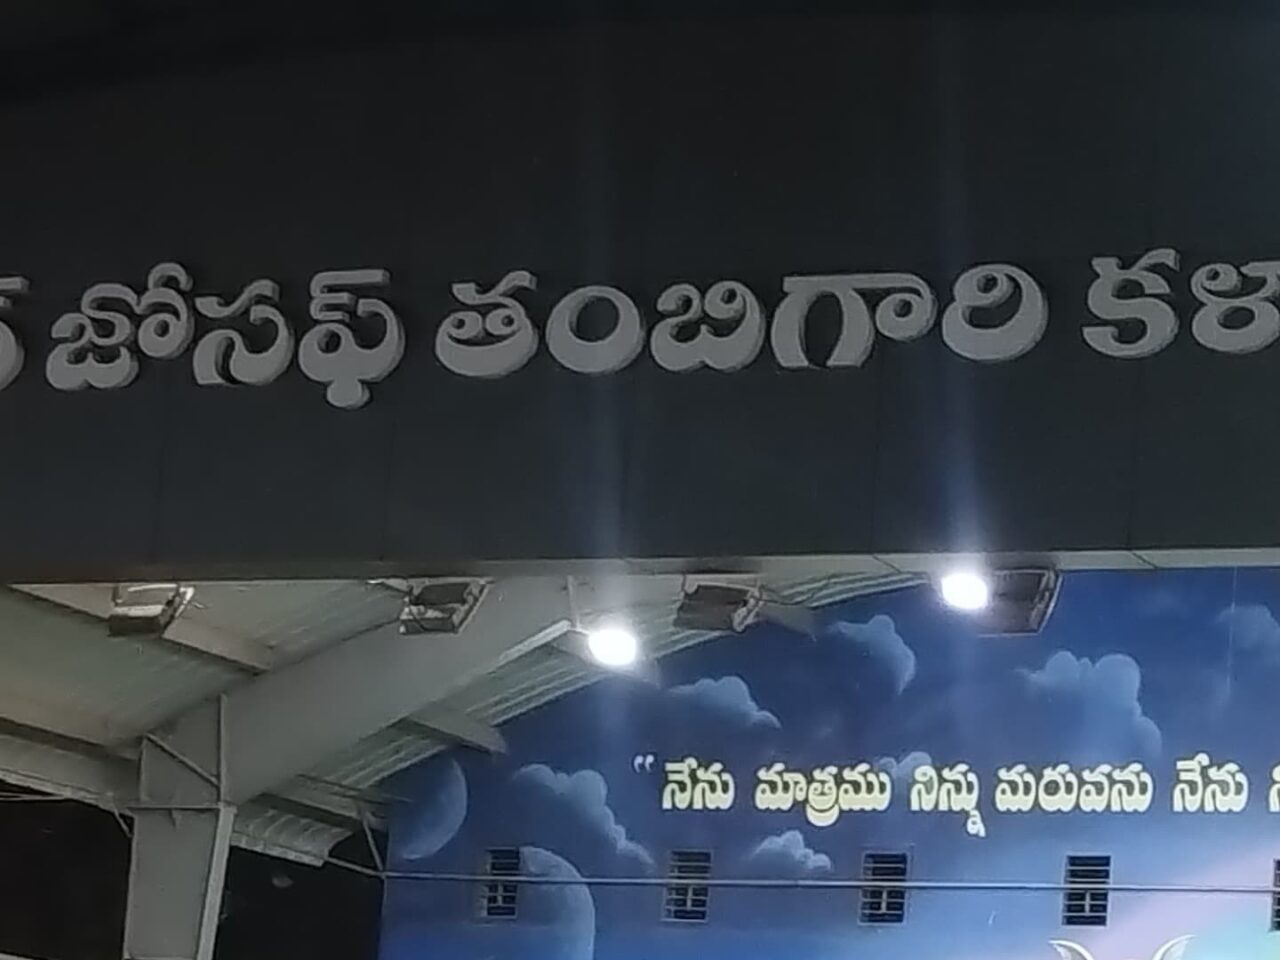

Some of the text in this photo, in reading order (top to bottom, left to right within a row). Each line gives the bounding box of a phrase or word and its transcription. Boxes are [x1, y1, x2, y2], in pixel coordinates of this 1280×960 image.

[755, 763, 892, 826] మాత్రము
[910, 763, 986, 837] నిన్ను
[995, 762, 1153, 812] మరువను
[1173, 753, 1248, 812] నేను
